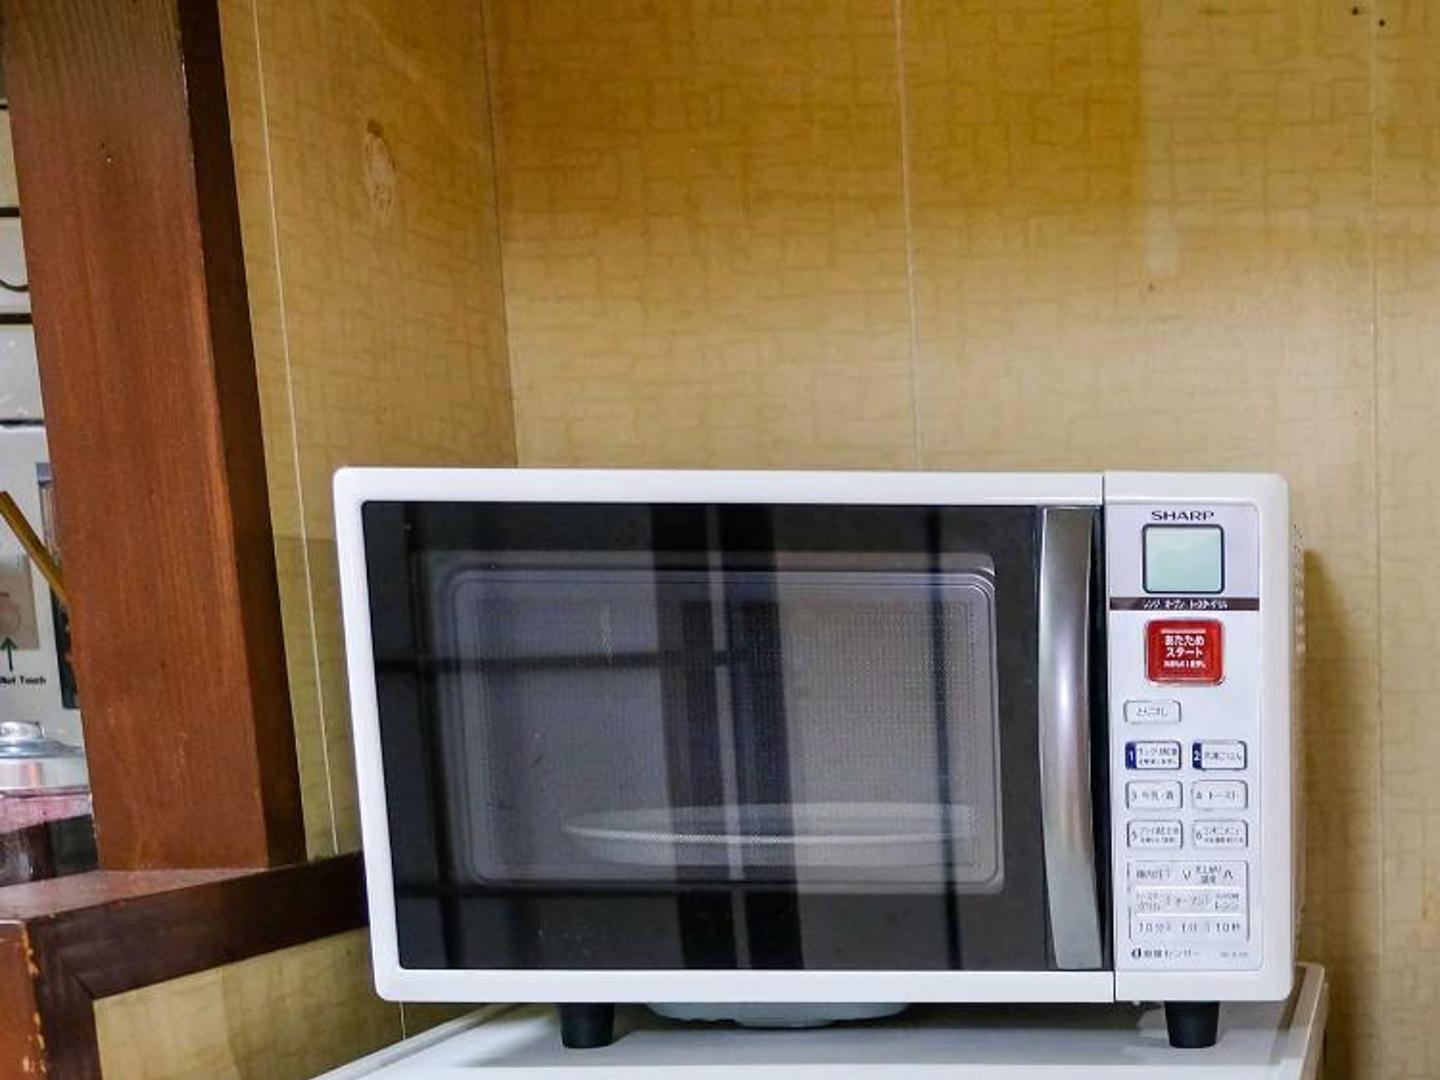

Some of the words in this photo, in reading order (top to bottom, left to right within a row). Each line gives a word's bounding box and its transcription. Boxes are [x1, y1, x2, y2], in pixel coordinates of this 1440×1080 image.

[1151, 510, 1214, 521] SHARP
[1166, 646, 1204, 659] スタート
